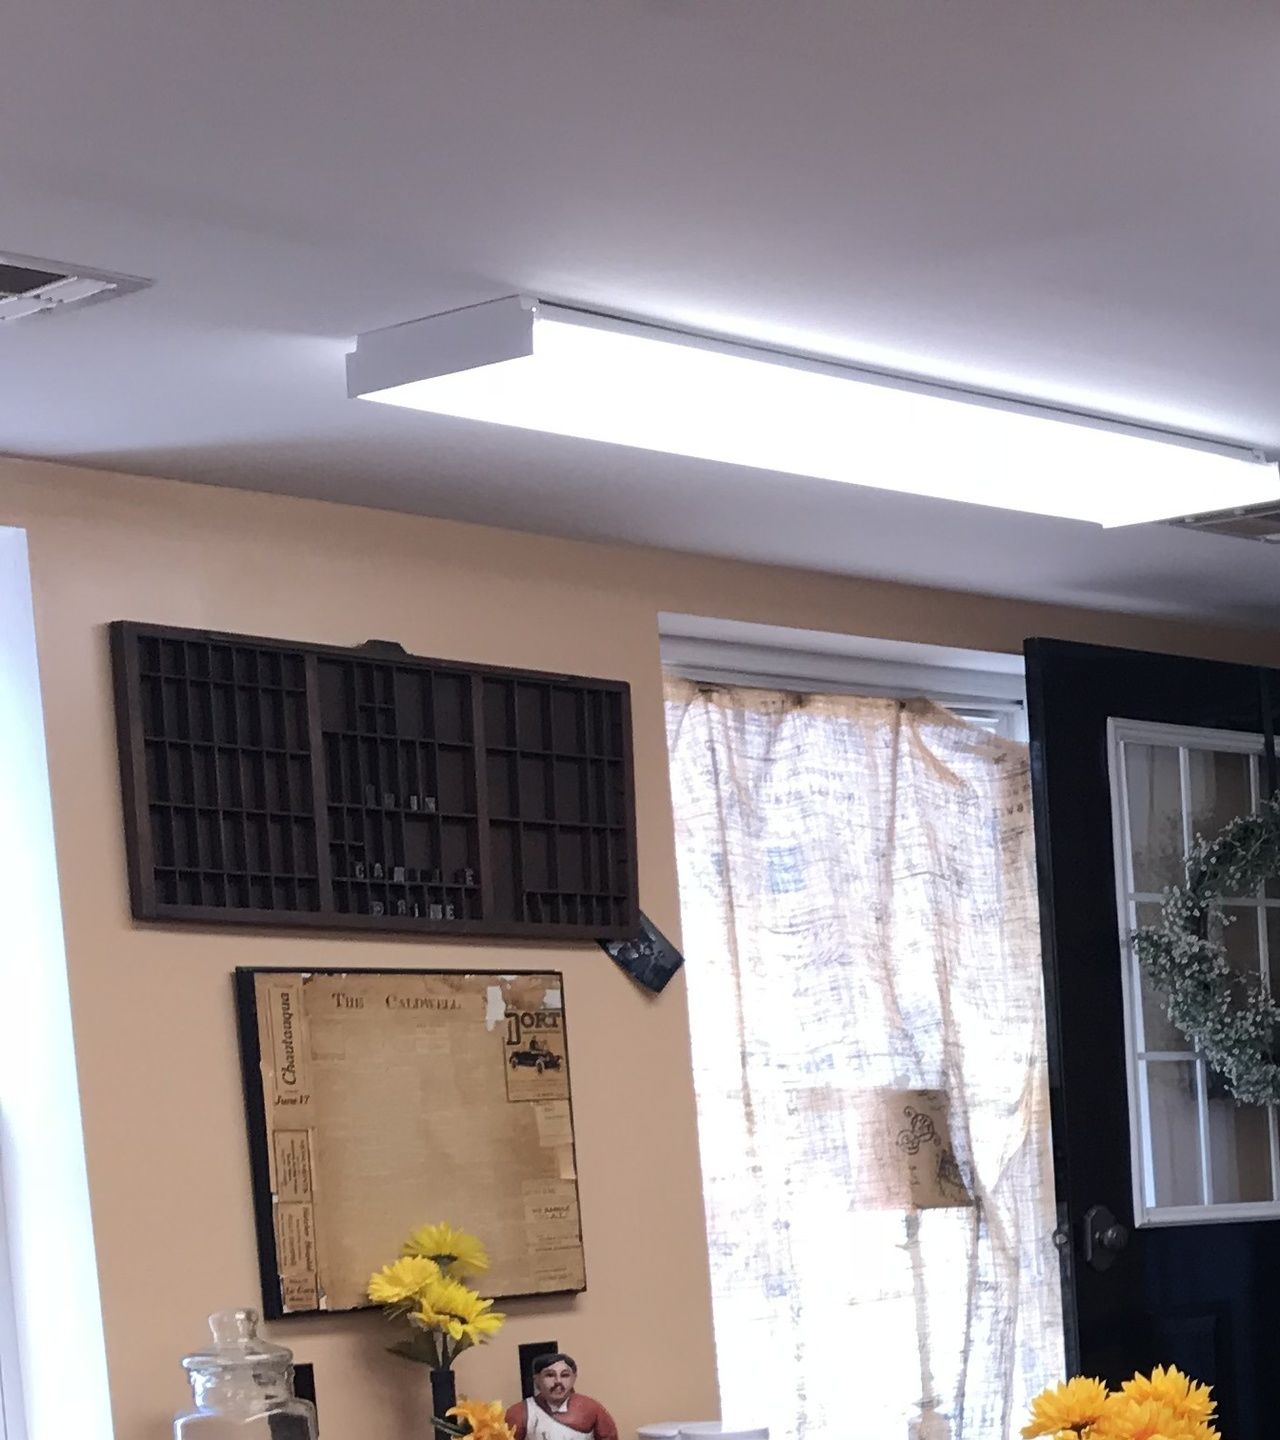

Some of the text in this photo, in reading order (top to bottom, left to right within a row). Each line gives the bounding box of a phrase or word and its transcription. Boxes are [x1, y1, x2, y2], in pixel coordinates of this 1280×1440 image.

[385, 994, 462, 1011] CALDWELL
[280, 992, 297, 1086] Chautauqua
[274, 1095, 297, 1106] June
